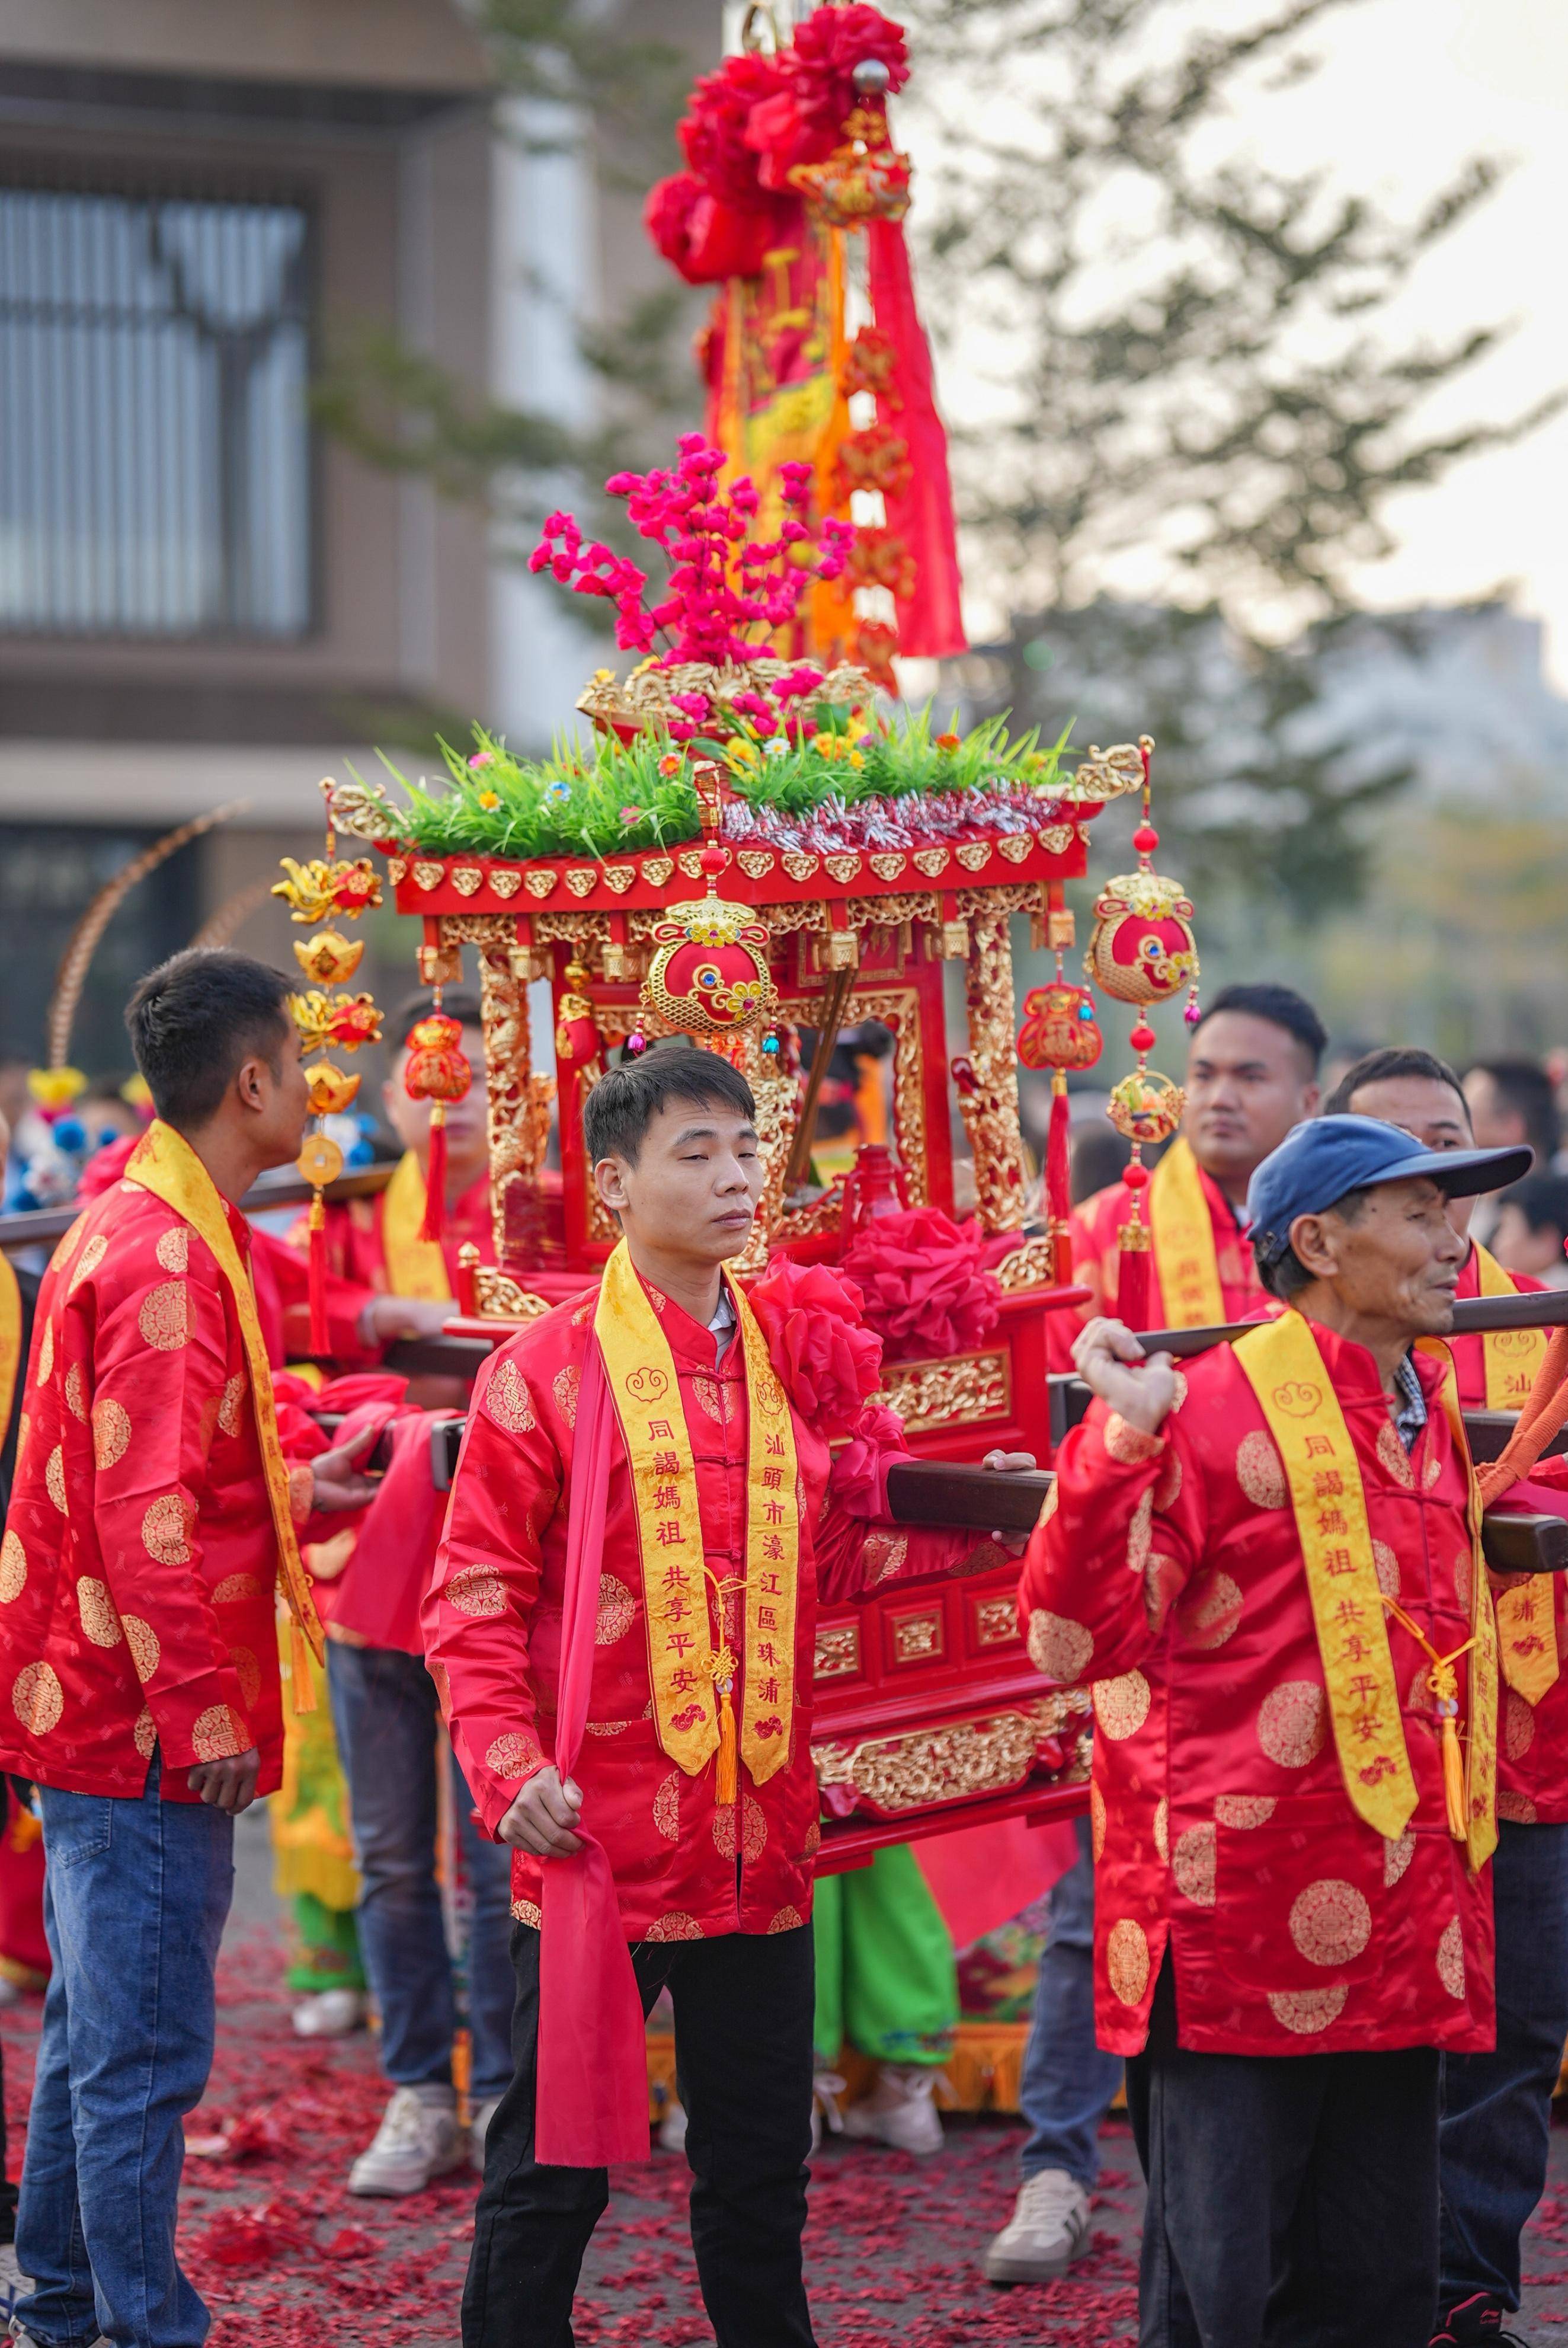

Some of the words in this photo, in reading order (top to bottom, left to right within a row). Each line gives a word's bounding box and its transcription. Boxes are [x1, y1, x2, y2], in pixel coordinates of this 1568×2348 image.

[757, 1433, 786, 1704] 汕頭市濠江區珠浦
